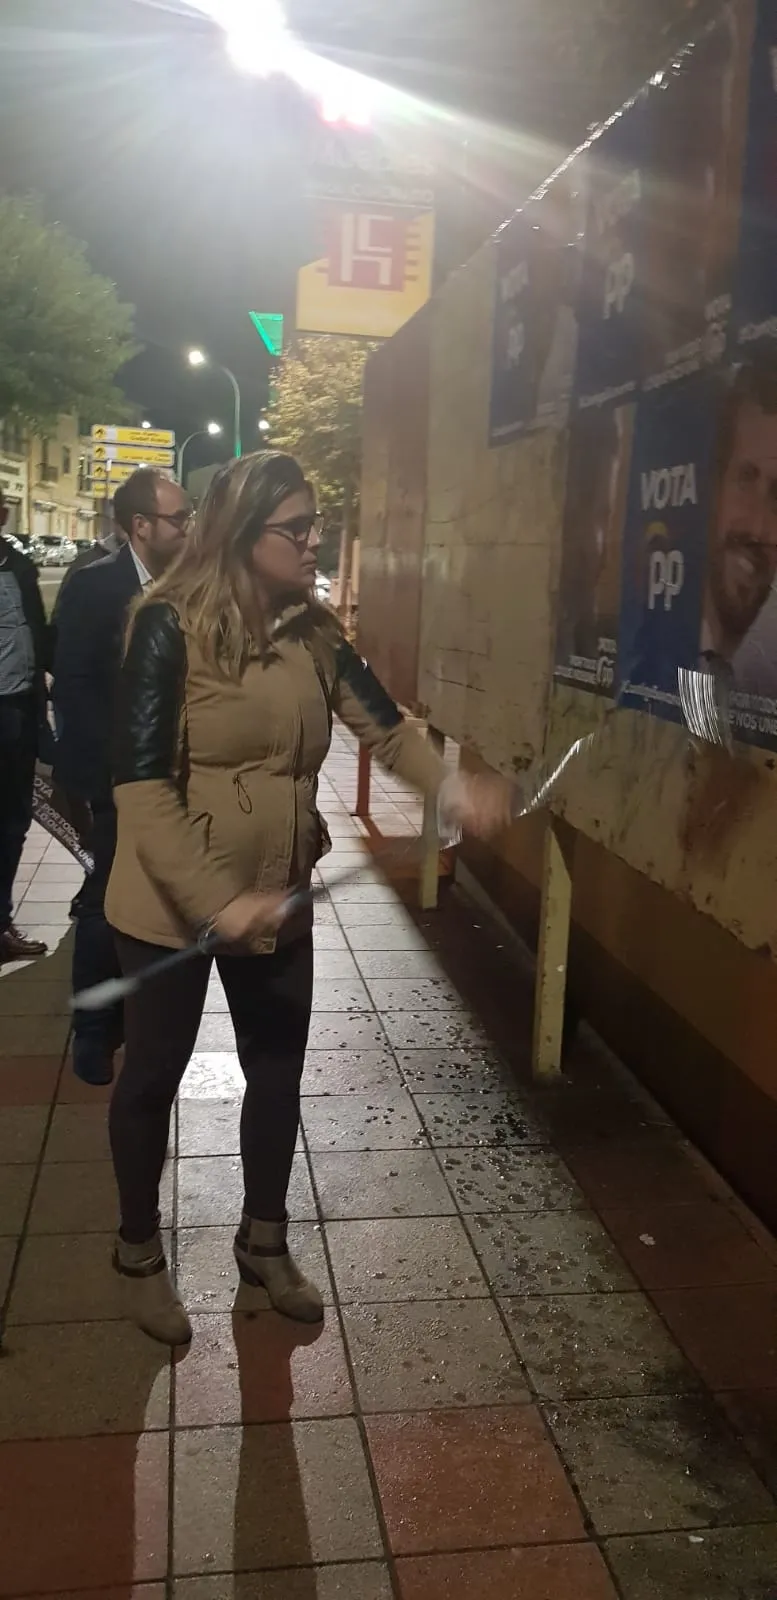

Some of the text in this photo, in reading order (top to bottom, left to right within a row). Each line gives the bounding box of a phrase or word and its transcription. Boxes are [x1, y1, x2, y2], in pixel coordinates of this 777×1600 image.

[640, 463, 698, 512] VOTA
[648, 550, 685, 612] pp
[736, 712, 757, 730] NOS
[33, 775, 54, 798] OTA
[35, 808, 49, 822] LO
[41, 803, 81, 841] POR TODO
